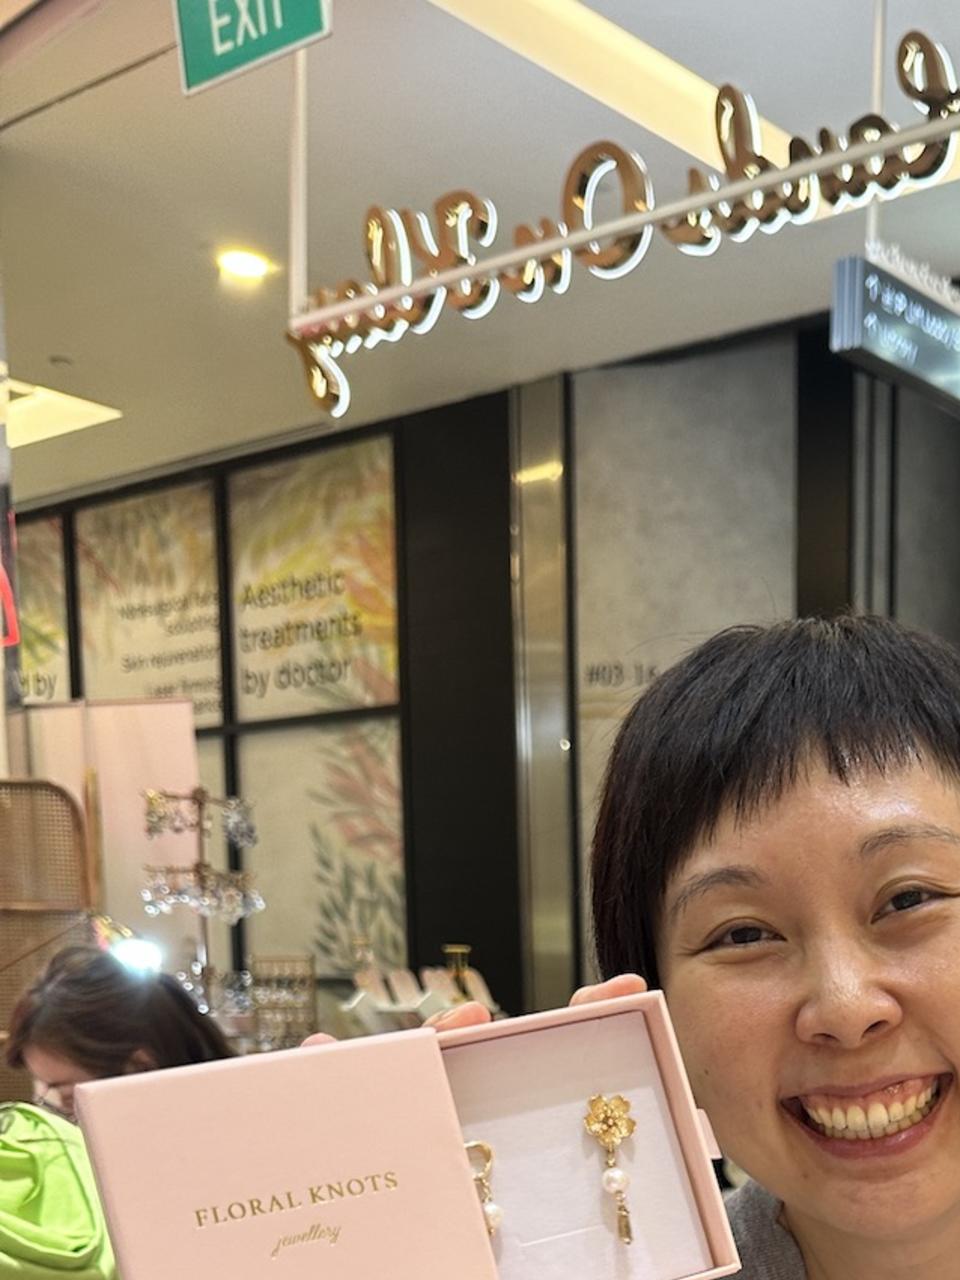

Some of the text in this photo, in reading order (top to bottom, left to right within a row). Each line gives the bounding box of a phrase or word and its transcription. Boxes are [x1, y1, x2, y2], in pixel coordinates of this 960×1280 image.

[243, 568, 346, 609] Aesthetic
[240, 608, 362, 652] treatments
[242, 668, 271, 698] by
[274, 657, 351, 690] doctor
[195, 1171, 398, 1229] FLORAL KNOTS
[270, 1223, 341, 1258] jewellery
